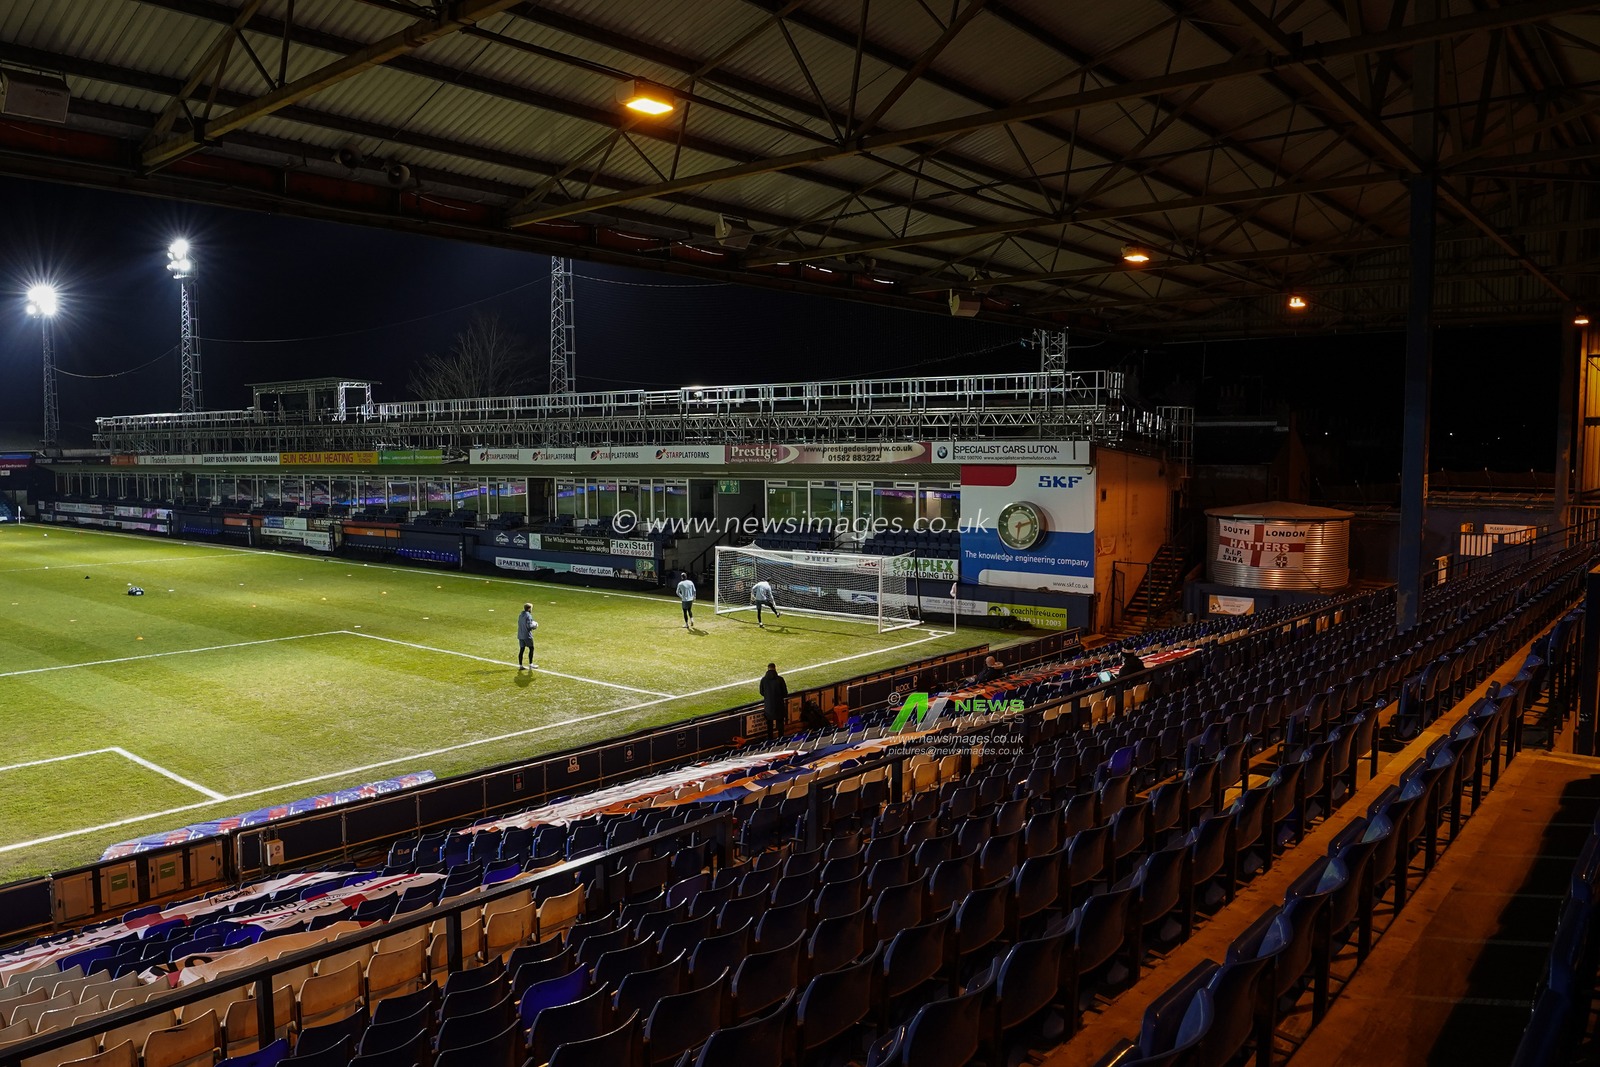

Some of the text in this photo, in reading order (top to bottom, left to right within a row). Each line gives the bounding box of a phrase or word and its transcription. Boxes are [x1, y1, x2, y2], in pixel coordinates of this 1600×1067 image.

[730, 446, 777, 459] Prestige
[954, 445, 1000, 454] SPECIALIST
[1002, 445, 1026, 454] CARS
[283, 453, 297, 463] SUN
[298, 453, 321, 463] REALM
[324, 453, 354, 463] HEATING
[1038, 475, 1082, 488] SKF
[1223, 525, 1306, 538] SOUTH LONDON
[610, 540, 654, 551] FlexiStaff
[1230, 539, 1290, 552] HATTERS
[612, 548, 630, 556] 01582
[502, 559, 530, 568] PARTSLINE
[965, 550, 1089, 568] The knowledge engineering company
[1222, 555, 1243, 564] SARA
[572, 565, 587, 573] Foster
[892, 557, 954, 573] COMPLEX
[892, 569, 939, 579] SCAFFOLDING
[942, 571, 954, 579] LTD
[1053, 581, 1089, 589] www.skf.co.uk
[1011, 608, 1066, 619] coachhire4u.com
